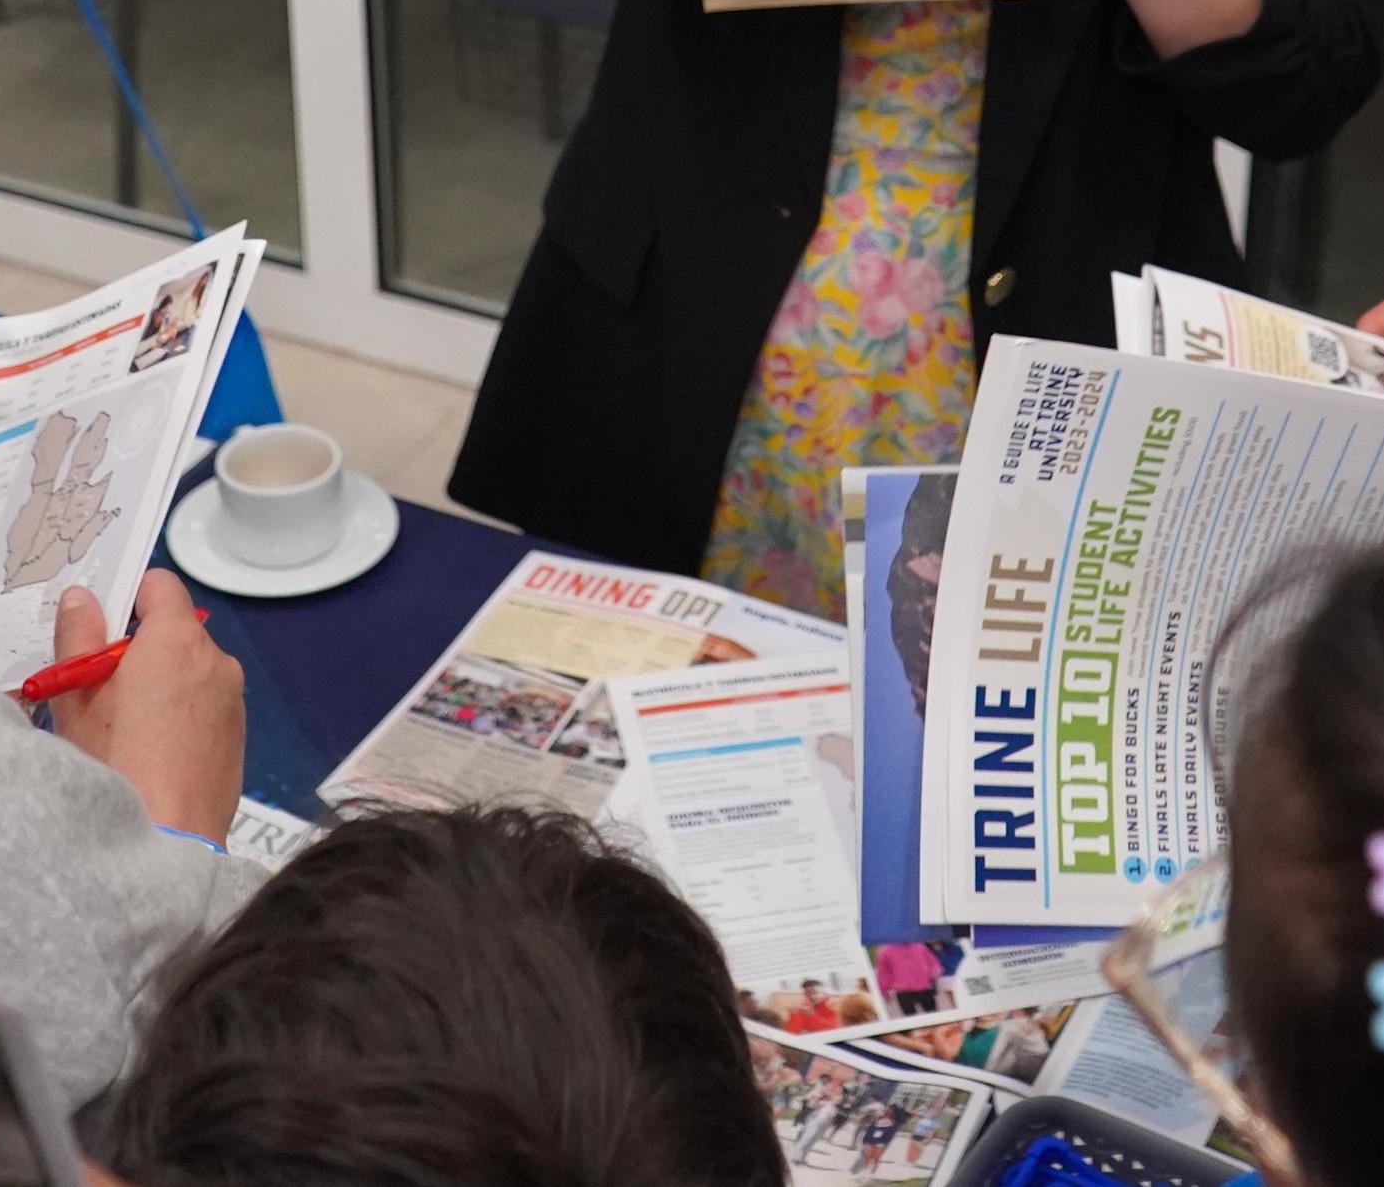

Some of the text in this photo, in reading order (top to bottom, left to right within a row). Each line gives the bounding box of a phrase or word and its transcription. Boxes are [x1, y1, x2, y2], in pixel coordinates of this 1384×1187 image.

[1183, 320, 1224, 362] NS
[999, 361, 1048, 485] A GUIDE TO LIFE
[1028, 364, 1068, 451] AT TRINE
[1036, 367, 1085, 481] UNIVERSITY
[1059, 369, 1109, 475] 2023-2024
[1095, 406, 1182, 645] LIFE ACTIVITIES
[524, 564, 659, 610] DINING
[660, 589, 724, 627] OPT
[1065, 499, 1118, 644] STUDENT
[978, 553, 1056, 662] LIFE
[1160, 610, 1182, 677] EVENTS
[1125, 687, 1140, 747] BUCKS
[1155, 681, 1172, 736] NIGHT
[1185, 661, 1204, 727] EVENTS
[973, 684, 1037, 893] TRINE
[1060, 657, 1113, 867] TOP 10
[1125, 754, 1138, 789] FOR
[1154, 741, 1168, 785] LATE
[1185, 735, 1198, 784] DAILY
[230, 814, 302, 856] TRI
[1126, 795, 1140, 852] BINGO
[1155, 789, 1170, 853] FINALS
[1185, 791, 1201, 854] FINALS
